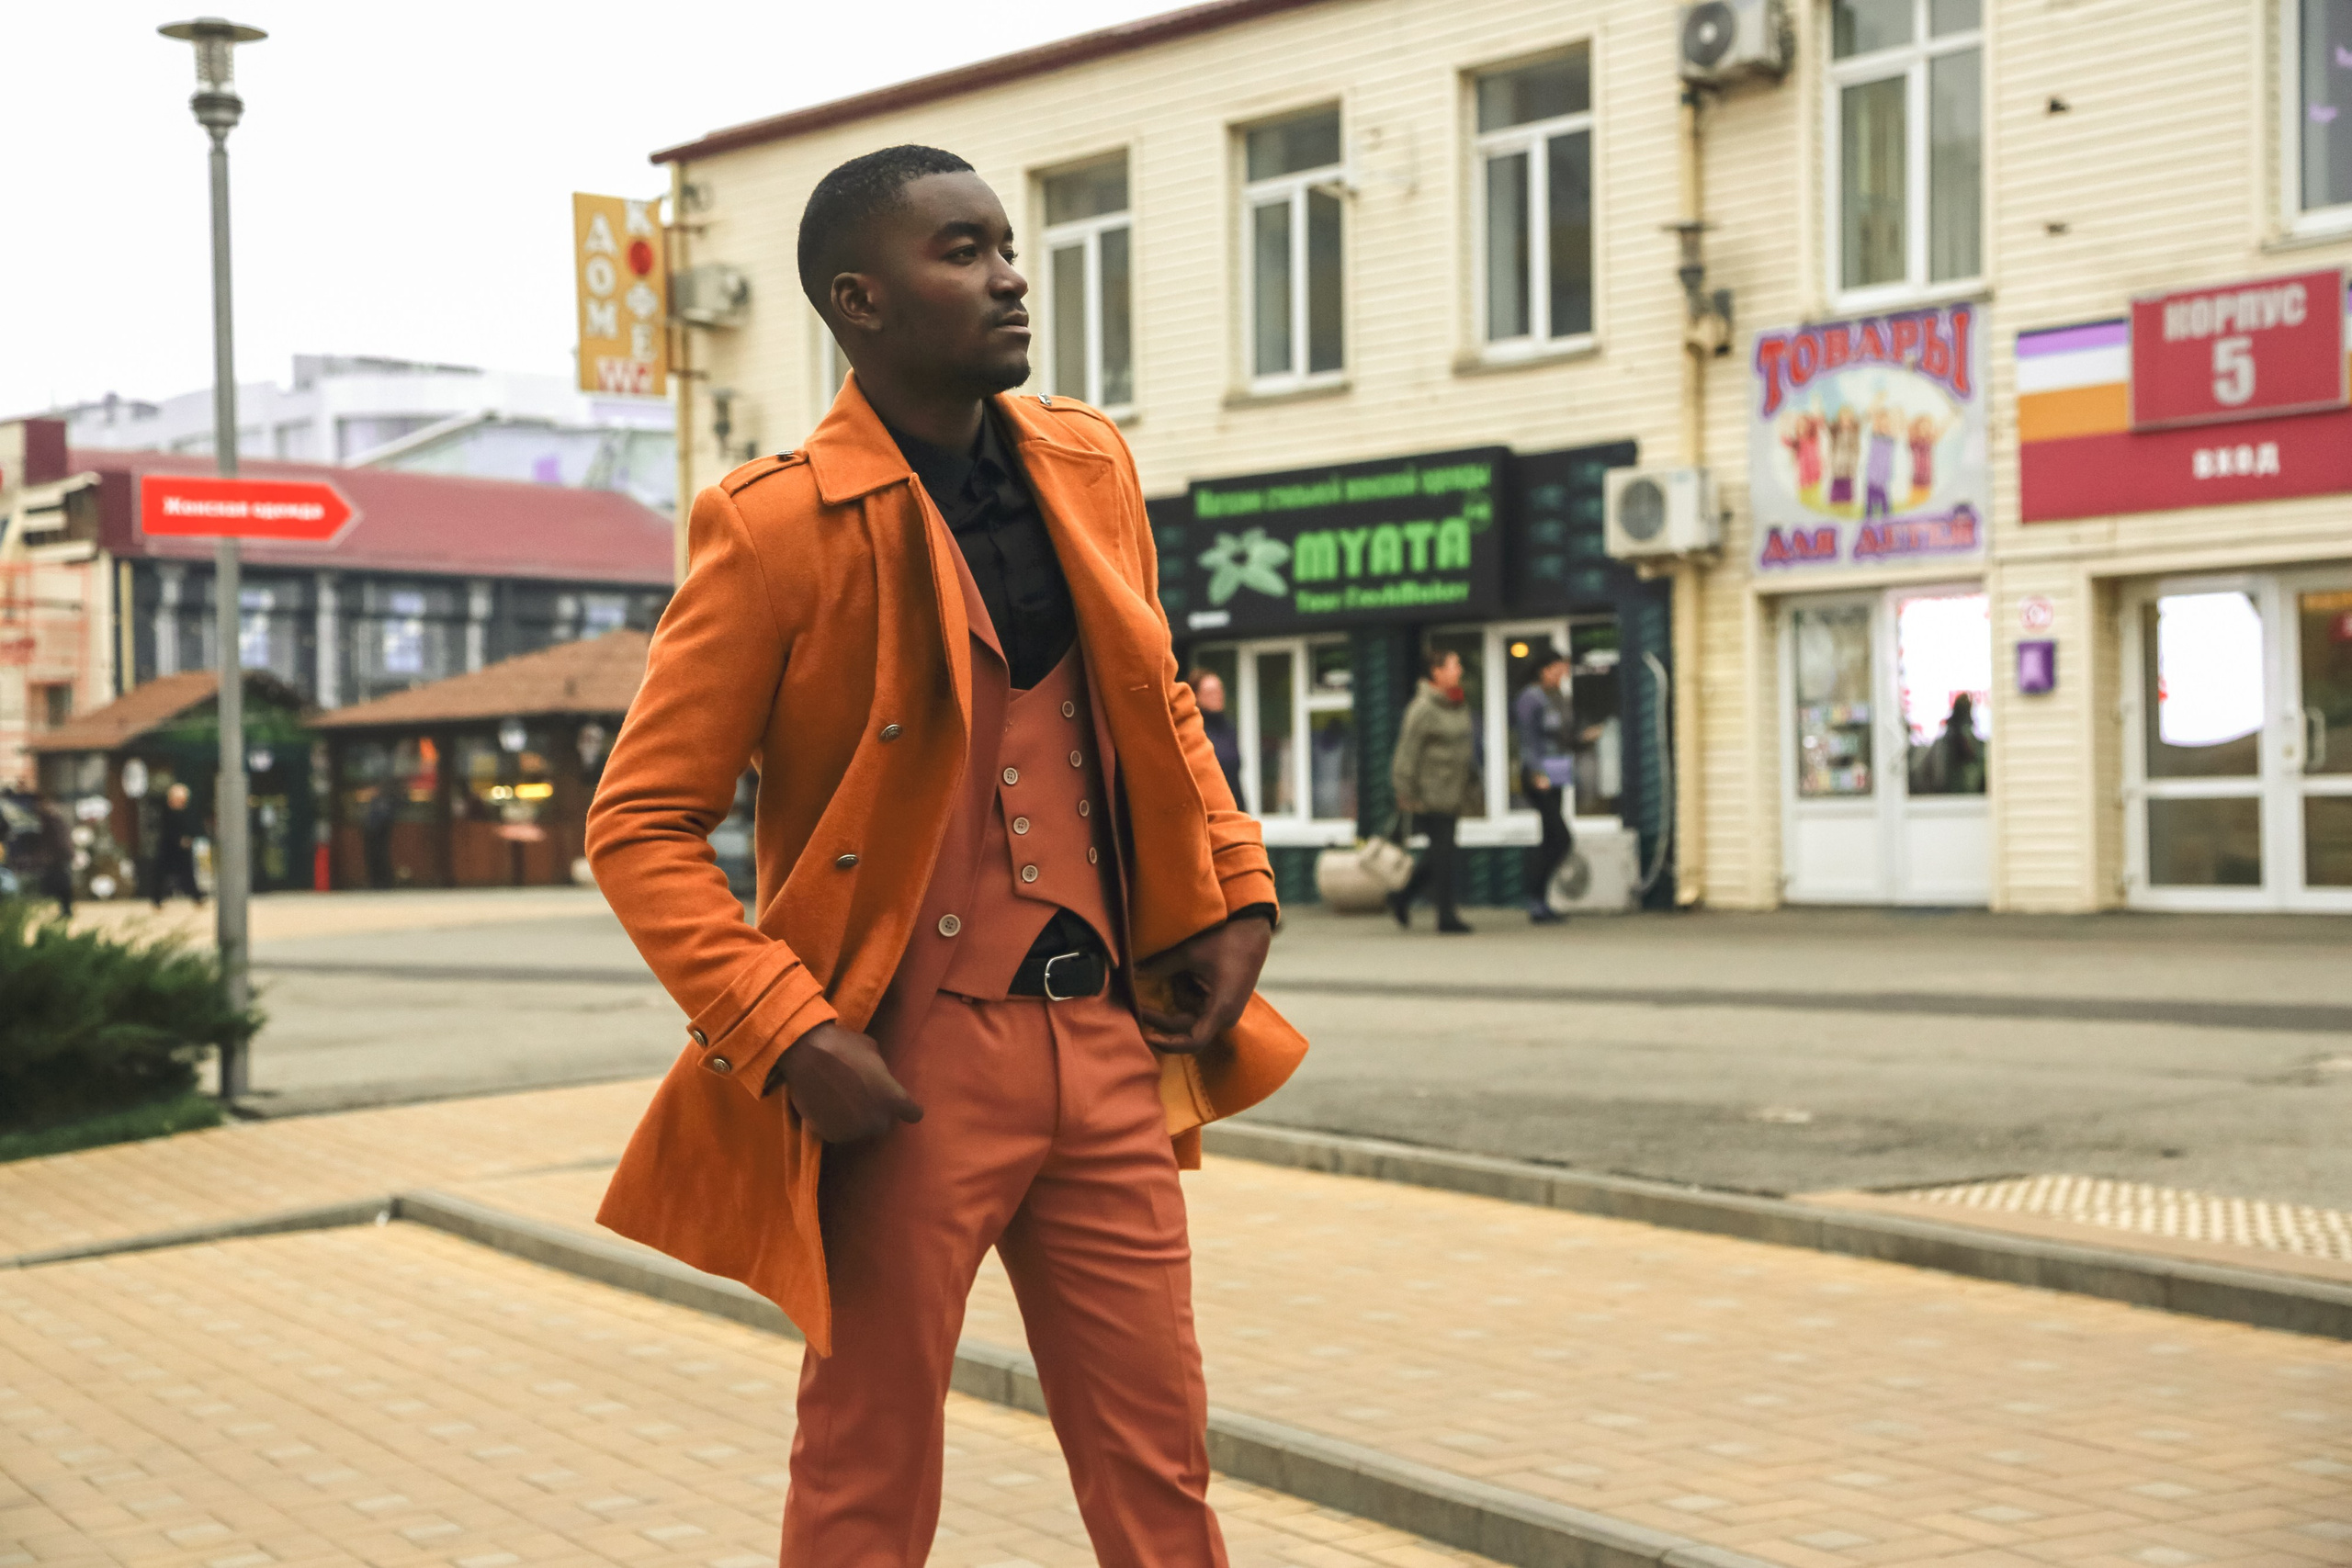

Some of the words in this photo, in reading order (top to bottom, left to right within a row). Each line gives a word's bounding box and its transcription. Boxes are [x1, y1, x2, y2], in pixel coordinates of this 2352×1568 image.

[2164, 283, 2307, 343] КОРПУС
[1758, 309, 1972, 416] ТОВАРЫ
[2212, 336, 2256, 406] 5
[2192, 440, 2280, 480] ВХОД
[1294, 516, 1471, 582] MYATA
